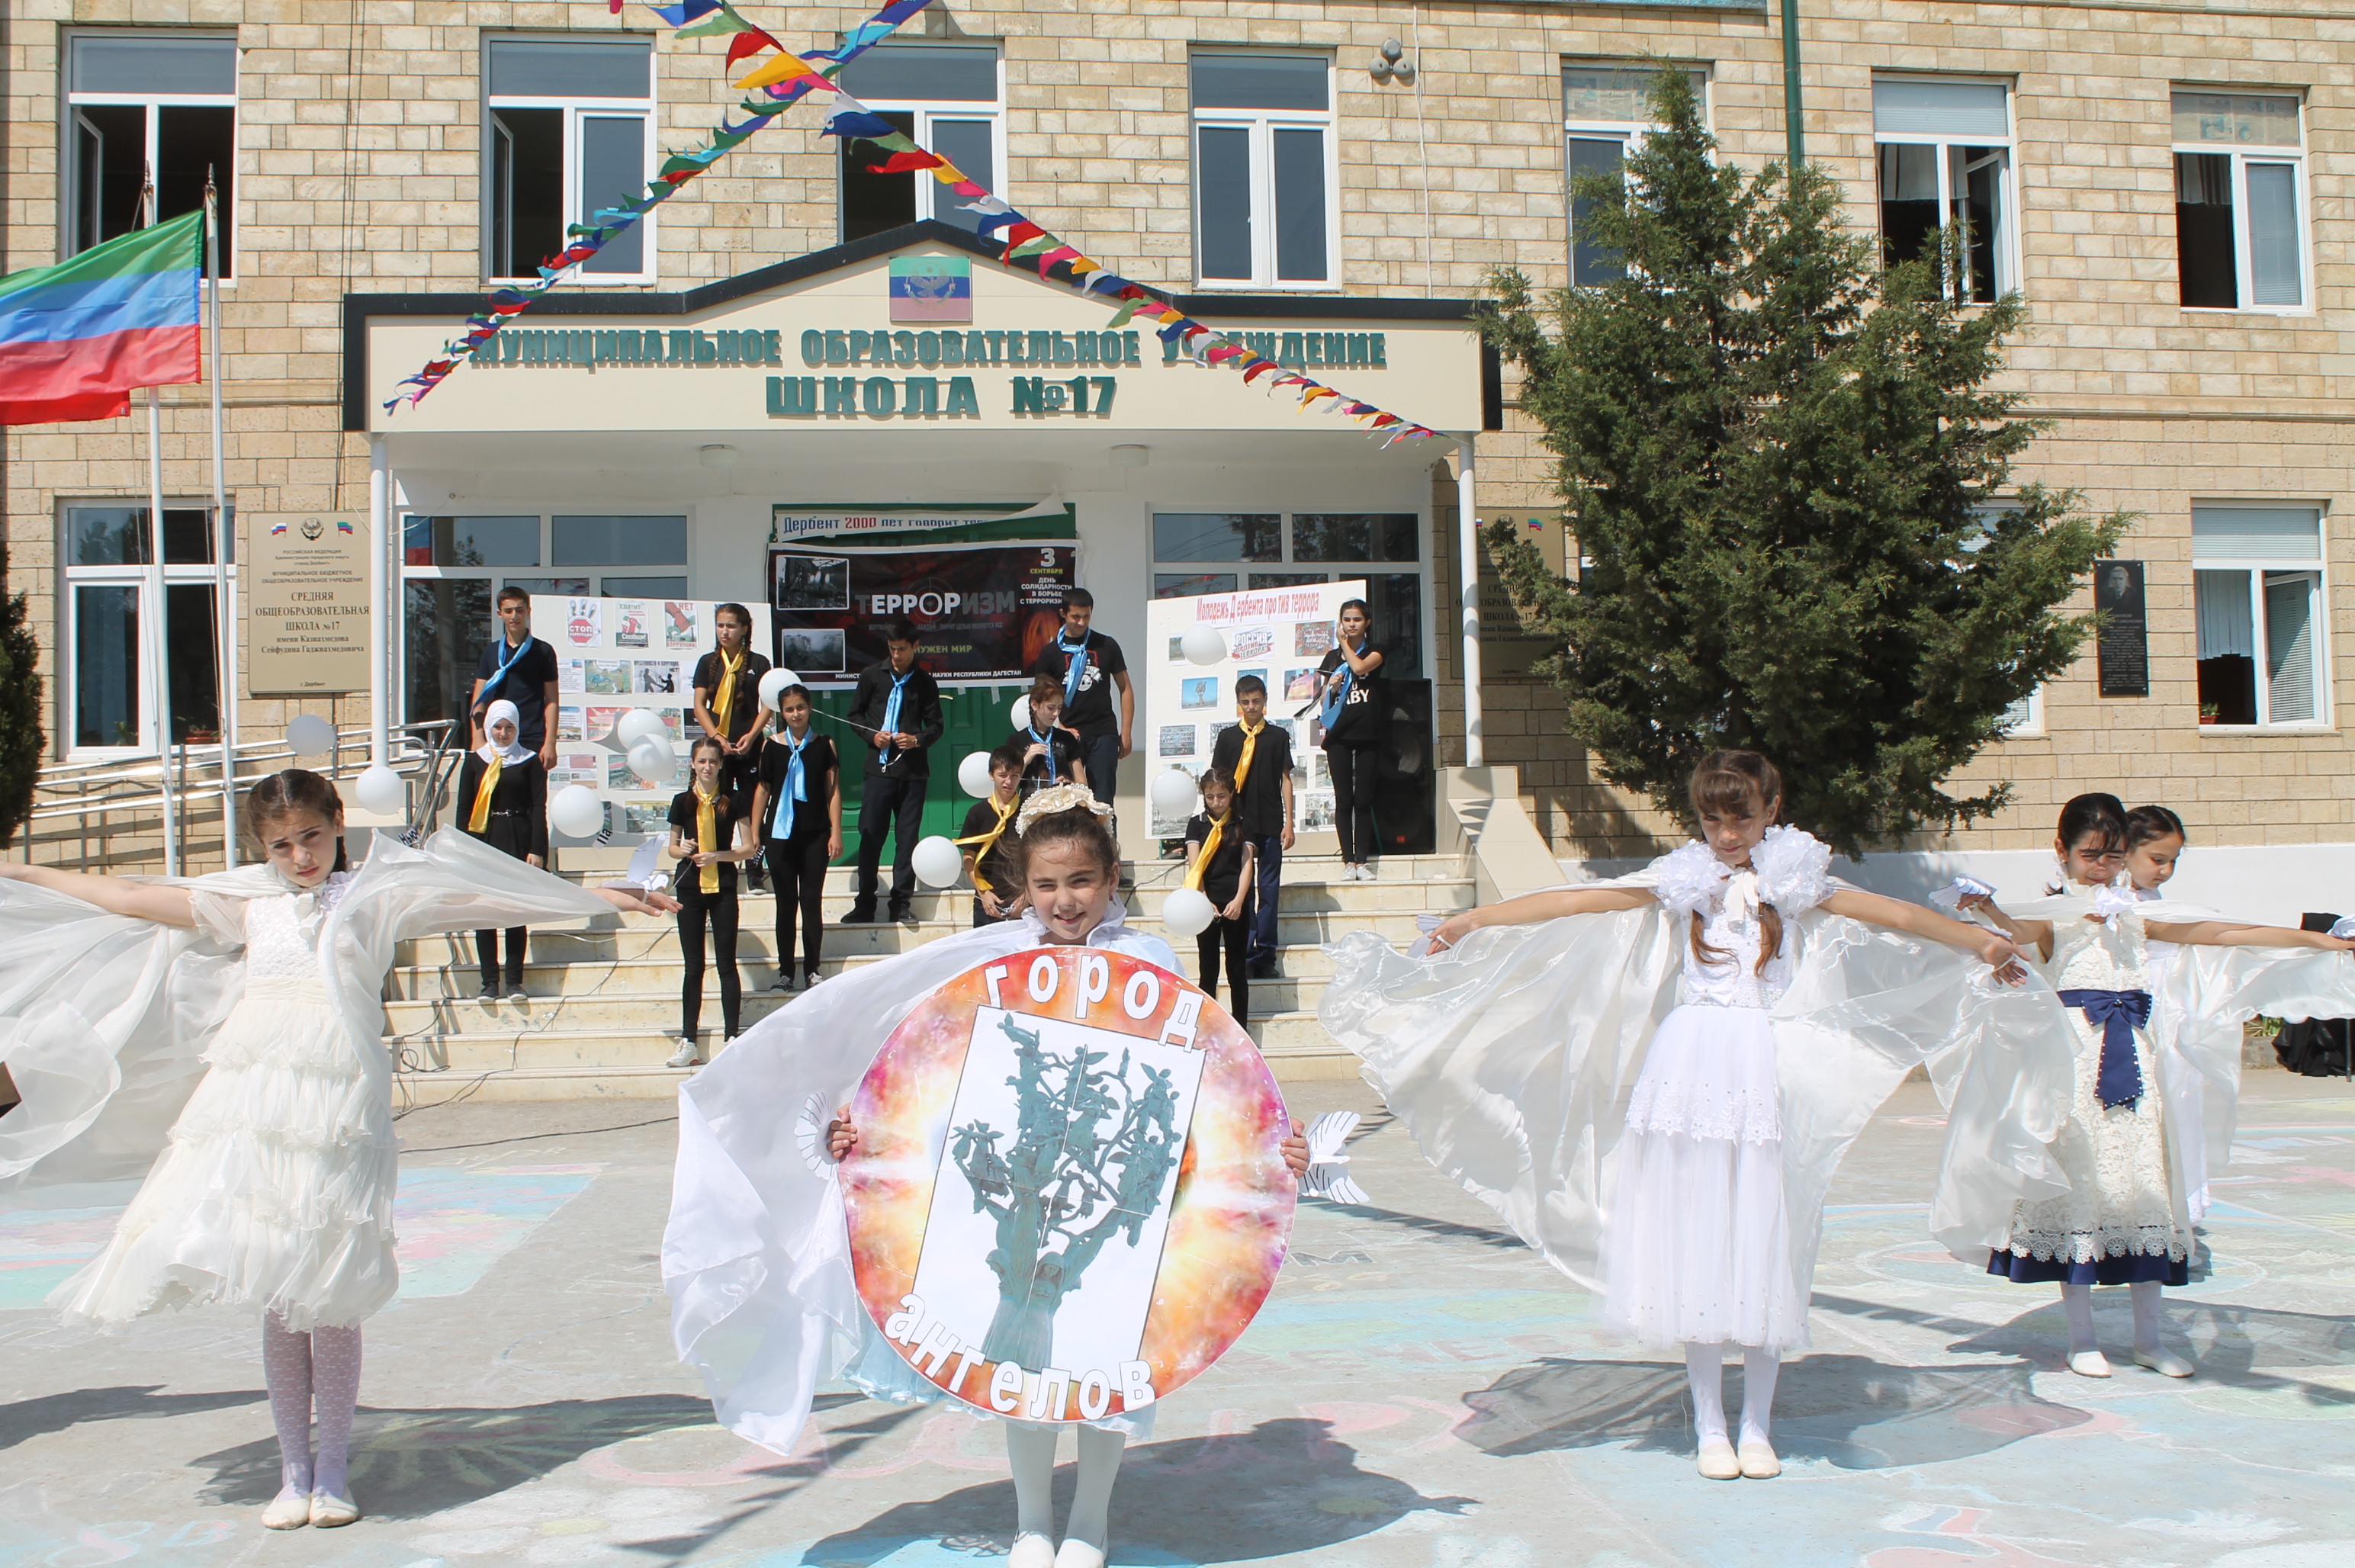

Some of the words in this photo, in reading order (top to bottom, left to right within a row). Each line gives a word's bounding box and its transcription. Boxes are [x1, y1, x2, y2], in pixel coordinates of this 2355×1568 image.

[801, 329, 1141, 364] ОБРАЗОВАТЕЛЬНОЕ
[766, 376, 980, 416] ШКОЛА
[1011, 376, 1116, 414] №17
[784, 516, 840, 535] Дербент
[845, 517, 877, 529] 2000
[882, 519, 903, 527] лет
[908, 519, 959, 528] говорит
[1040, 548, 1055, 567] 3
[291, 591, 334, 601] СРЕДНЯЯ
[854, 590, 1016, 615] ТЕРРОРИЗМ
[1291, 591, 1319, 619] террора
[255, 606, 369, 617] ОБЩЕОБРАЗОВАТЕЛЬНАЯ
[1483, 612, 1515, 622] ШКОЛА
[285, 622, 320, 631] ШКОЛА
[323, 621, 340, 631] №17
[1235, 632, 1268, 647] РОССИЯ
[1235, 641, 1258, 653] ПРОТИВ
[984, 953, 1204, 1053] город
[884, 1292, 1157, 1422] ангелов
